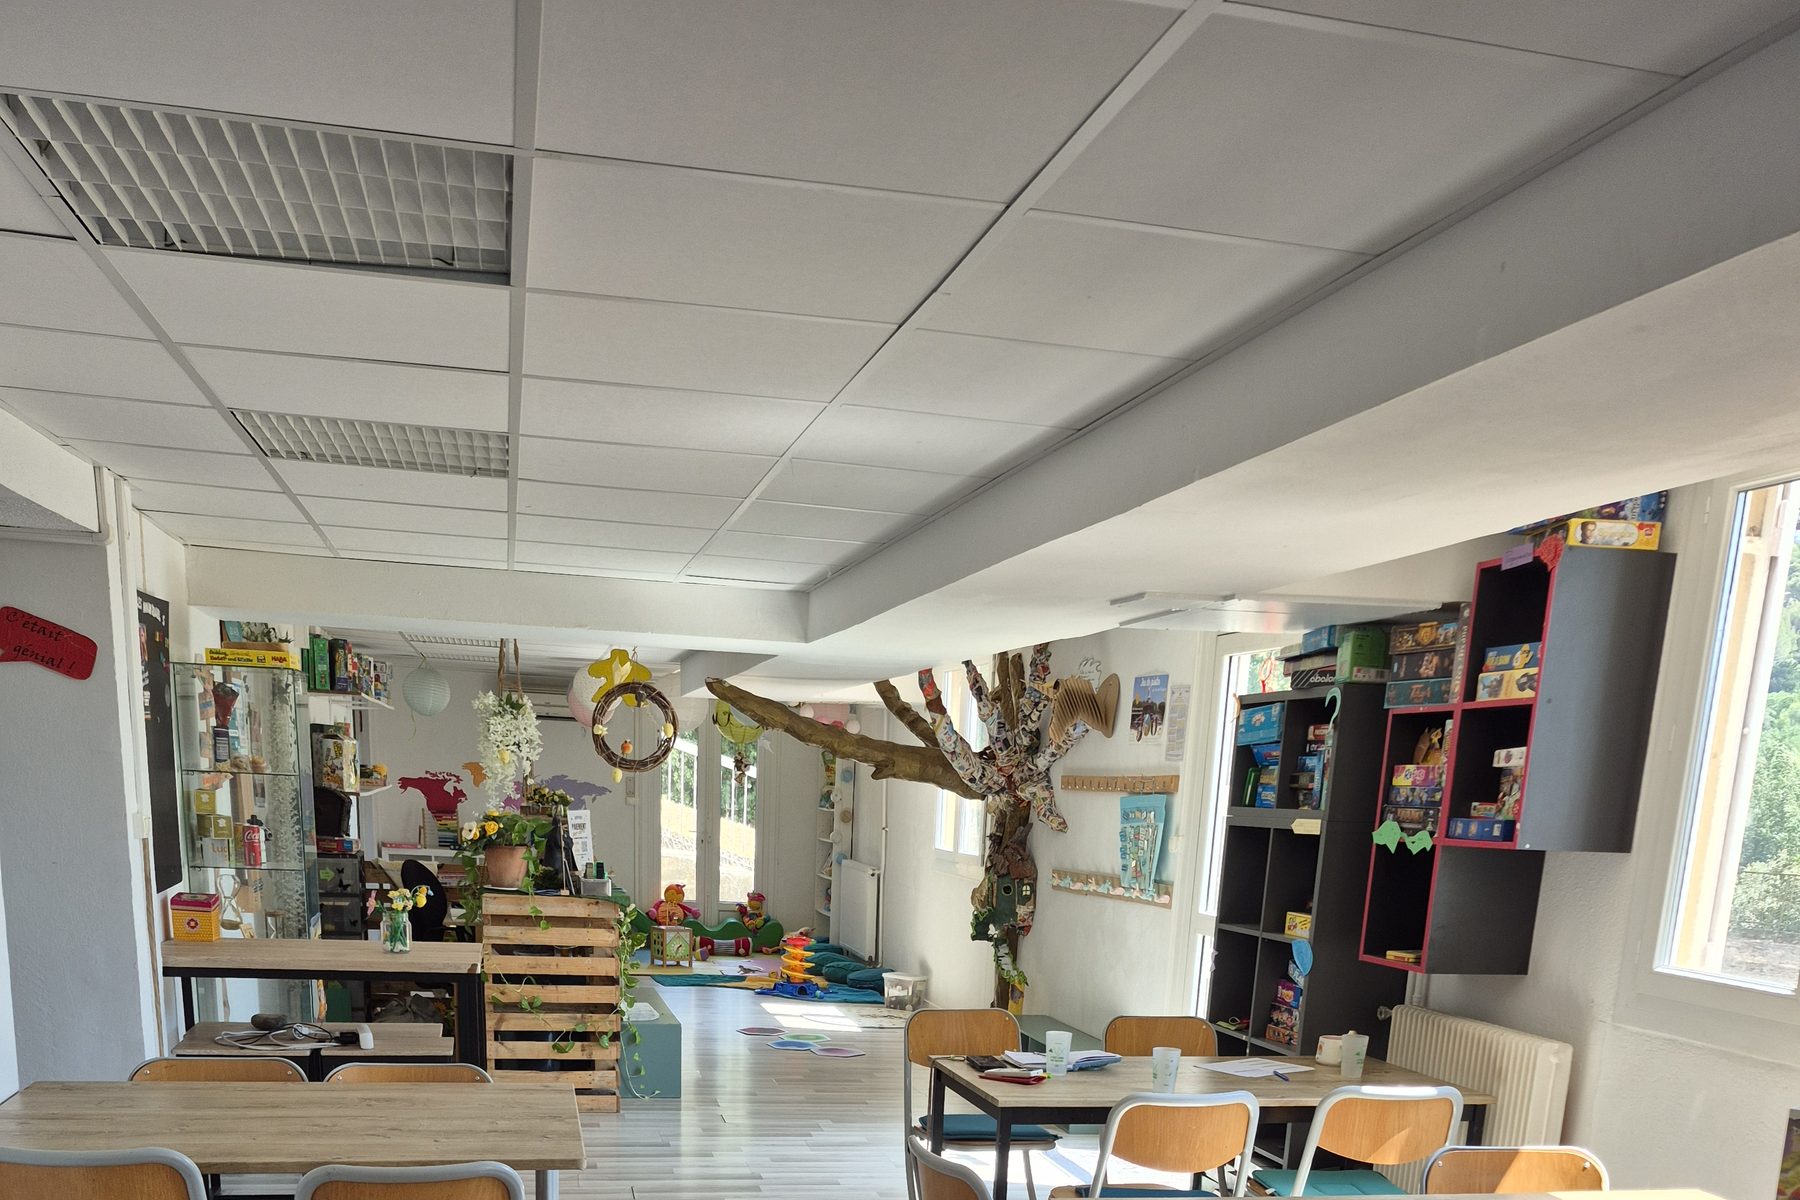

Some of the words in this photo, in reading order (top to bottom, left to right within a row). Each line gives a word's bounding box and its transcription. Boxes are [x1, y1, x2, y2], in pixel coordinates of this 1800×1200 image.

[6, 611, 65, 642] C'était
[271, 655, 288, 664] HABA
[67, 660, 77, 673] !
